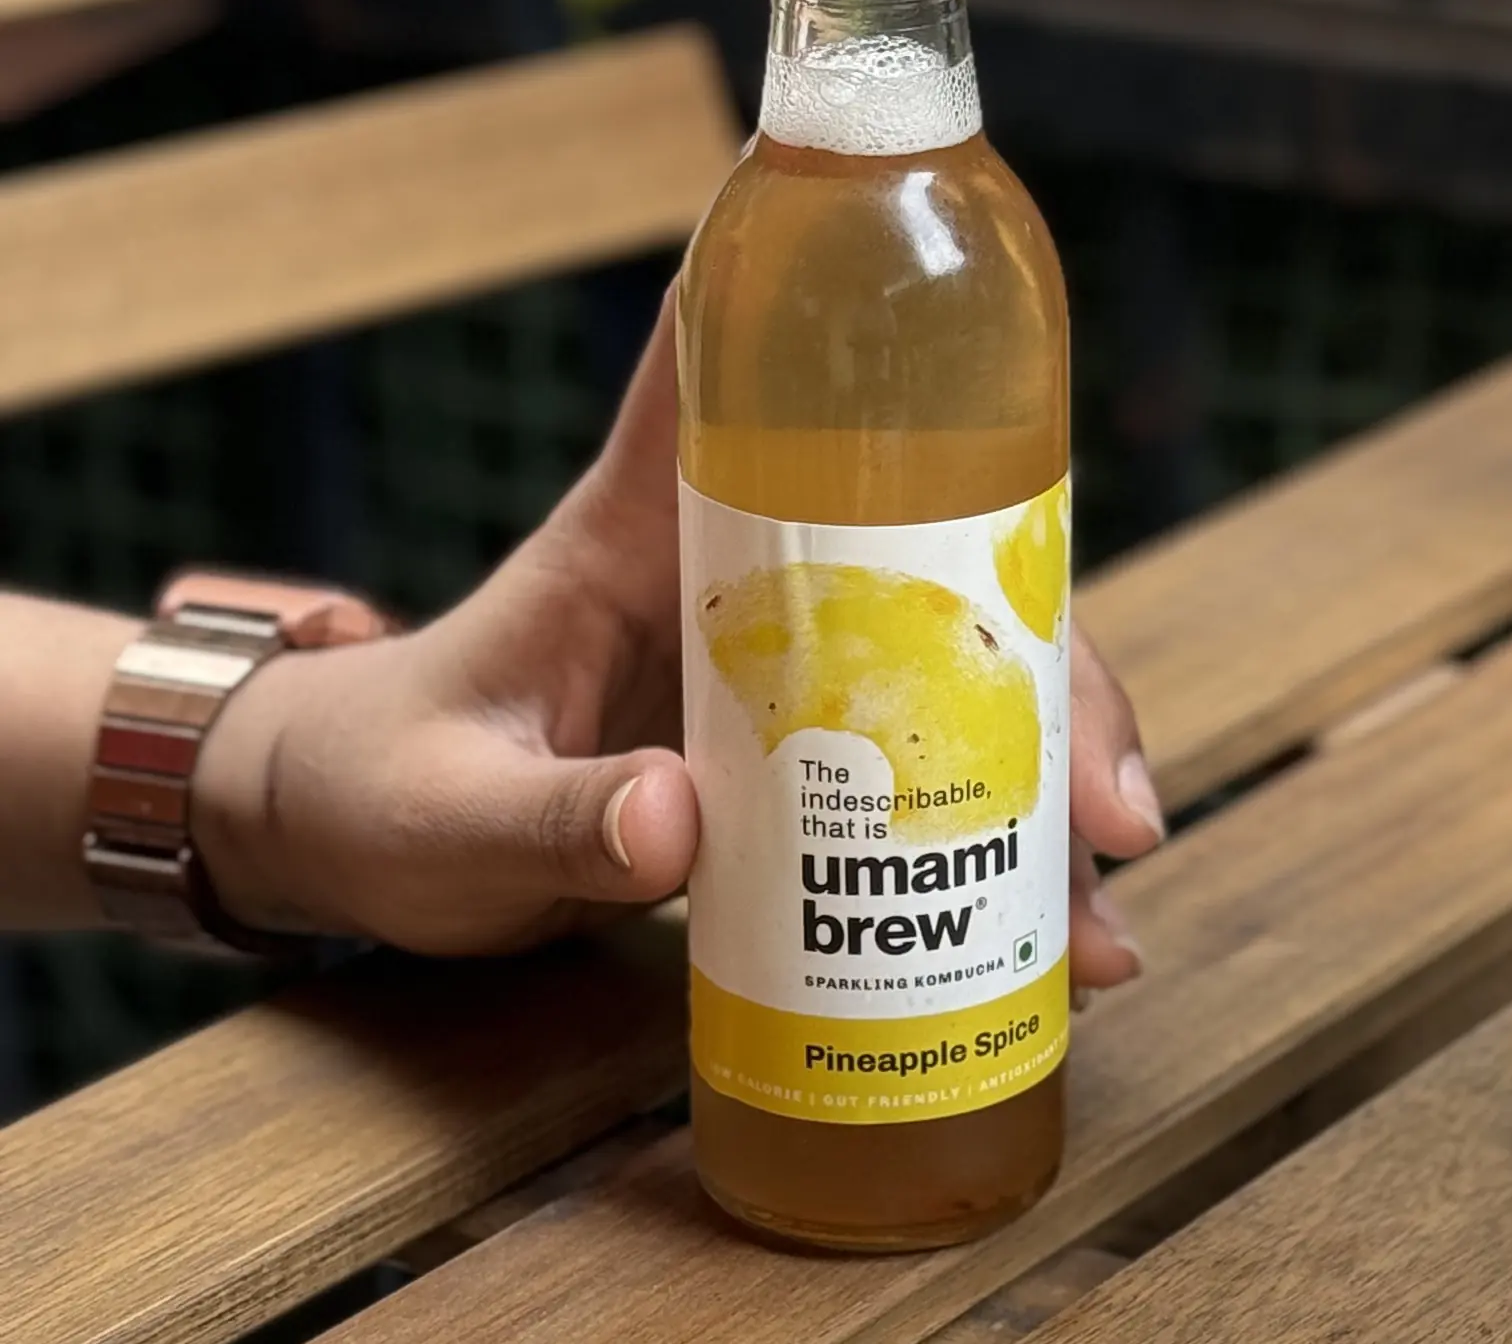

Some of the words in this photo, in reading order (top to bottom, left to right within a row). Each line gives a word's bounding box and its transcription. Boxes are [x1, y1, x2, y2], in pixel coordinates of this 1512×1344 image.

[800, 760, 849, 783] The
[801, 779, 991, 812] indescribable,
[801, 814, 855, 839] that
[865, 818, 887, 839] is
[802, 817, 1017, 896] umami
[805, 974, 908, 992] SPARKLING
[914, 957, 1005, 989] KOMBUCHA
[805, 1040, 967, 1077] Pineapple
[974, 1014, 1040, 1057] Spice
[737, 1072, 803, 1103] CALORIE
[823, 1095, 859, 1107] GUT
[868, 1087, 961, 1108] FRIENDLY
